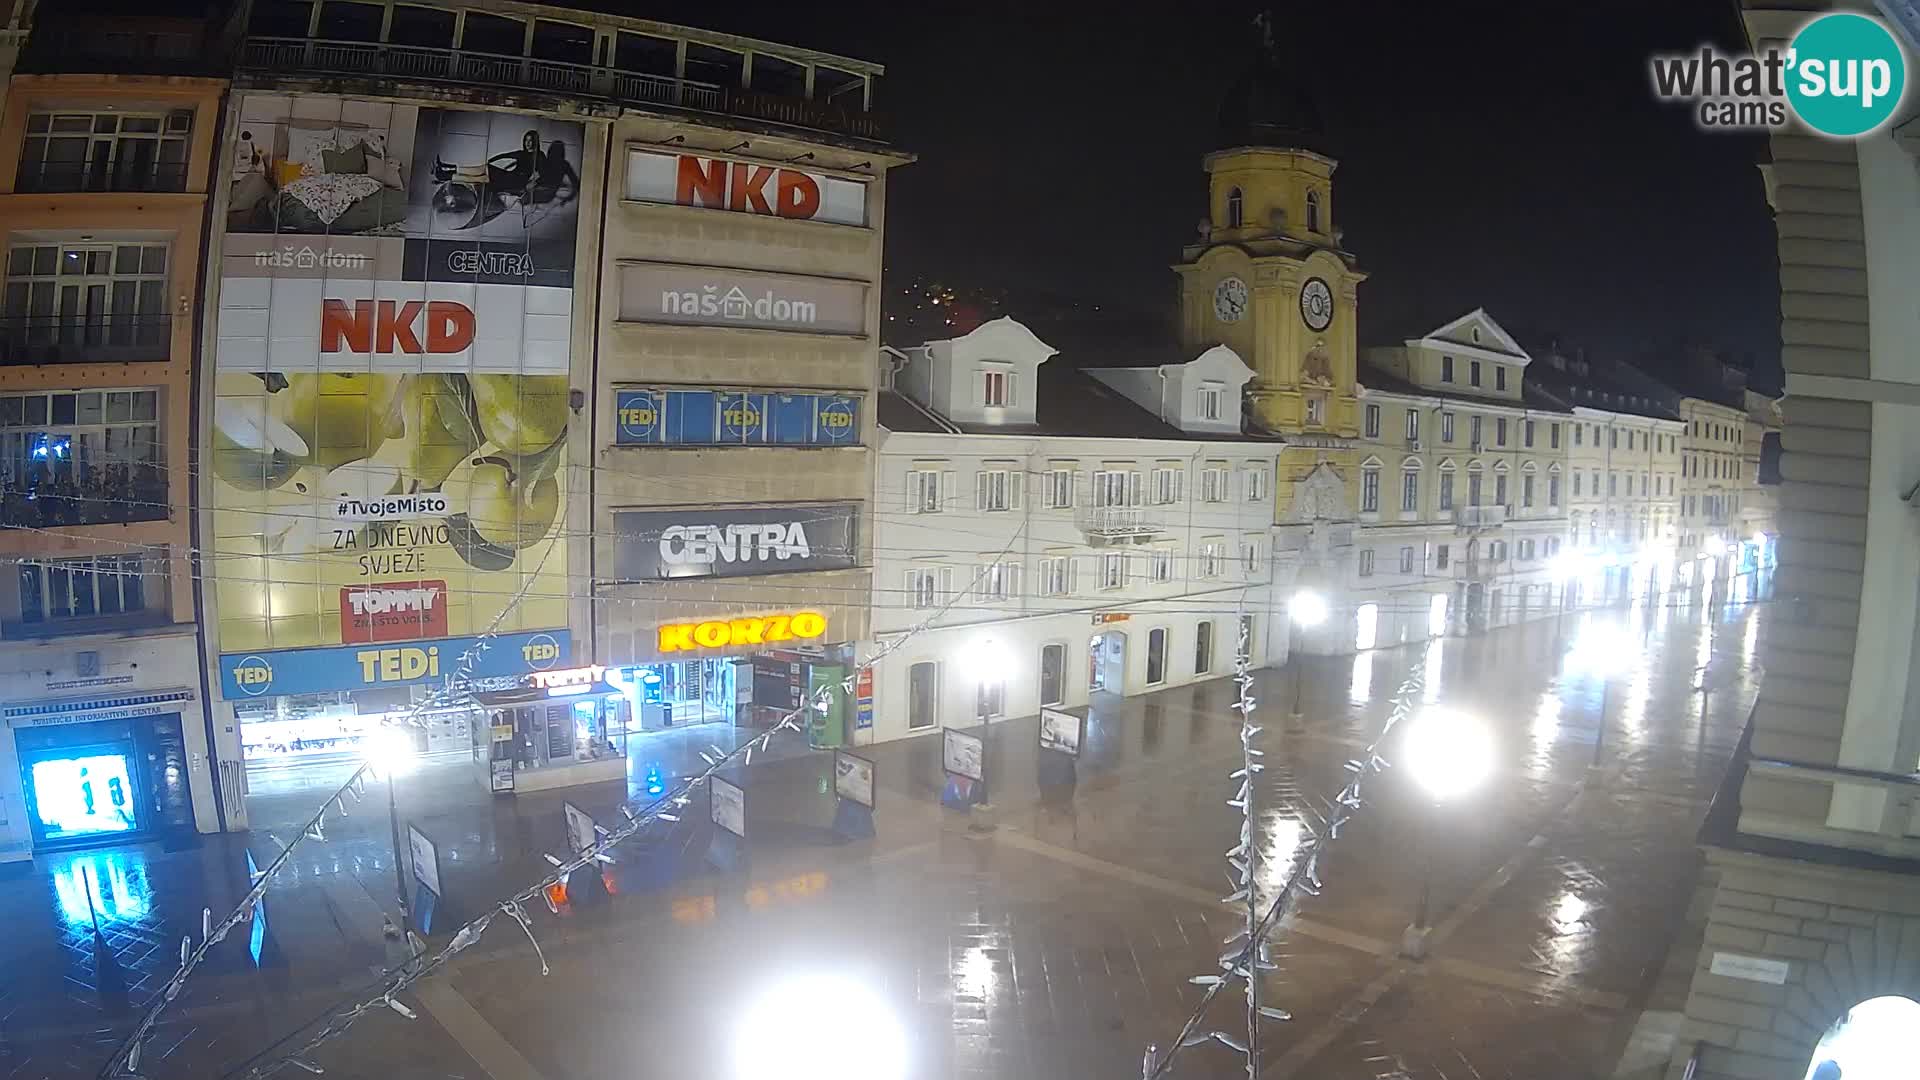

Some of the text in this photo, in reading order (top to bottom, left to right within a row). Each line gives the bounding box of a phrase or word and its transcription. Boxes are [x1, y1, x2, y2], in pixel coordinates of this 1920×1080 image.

[676, 155, 821, 220] NKD
[255, 245, 366, 270] naš dom
[448, 250, 536, 277] CENTRA
[662, 285, 817, 323] naš dom
[321, 299, 477, 354] NKD
[337, 496, 446, 517] #TvojeMisto
[333, 525, 450, 550] ZA DNEVNO
[659, 522, 810, 564] CENTRA
[359, 546, 426, 576] SVJEŽE
[349, 589, 437, 615] TOMMY
[659, 612, 826, 652] KORZO
[357, 646, 439, 682] TEDi
[522, 644, 560, 661] TEDi
[233, 666, 273, 684] TEDi
[532, 665, 605, 688] TOMMY
[132, 706, 162, 717] CENTAR
